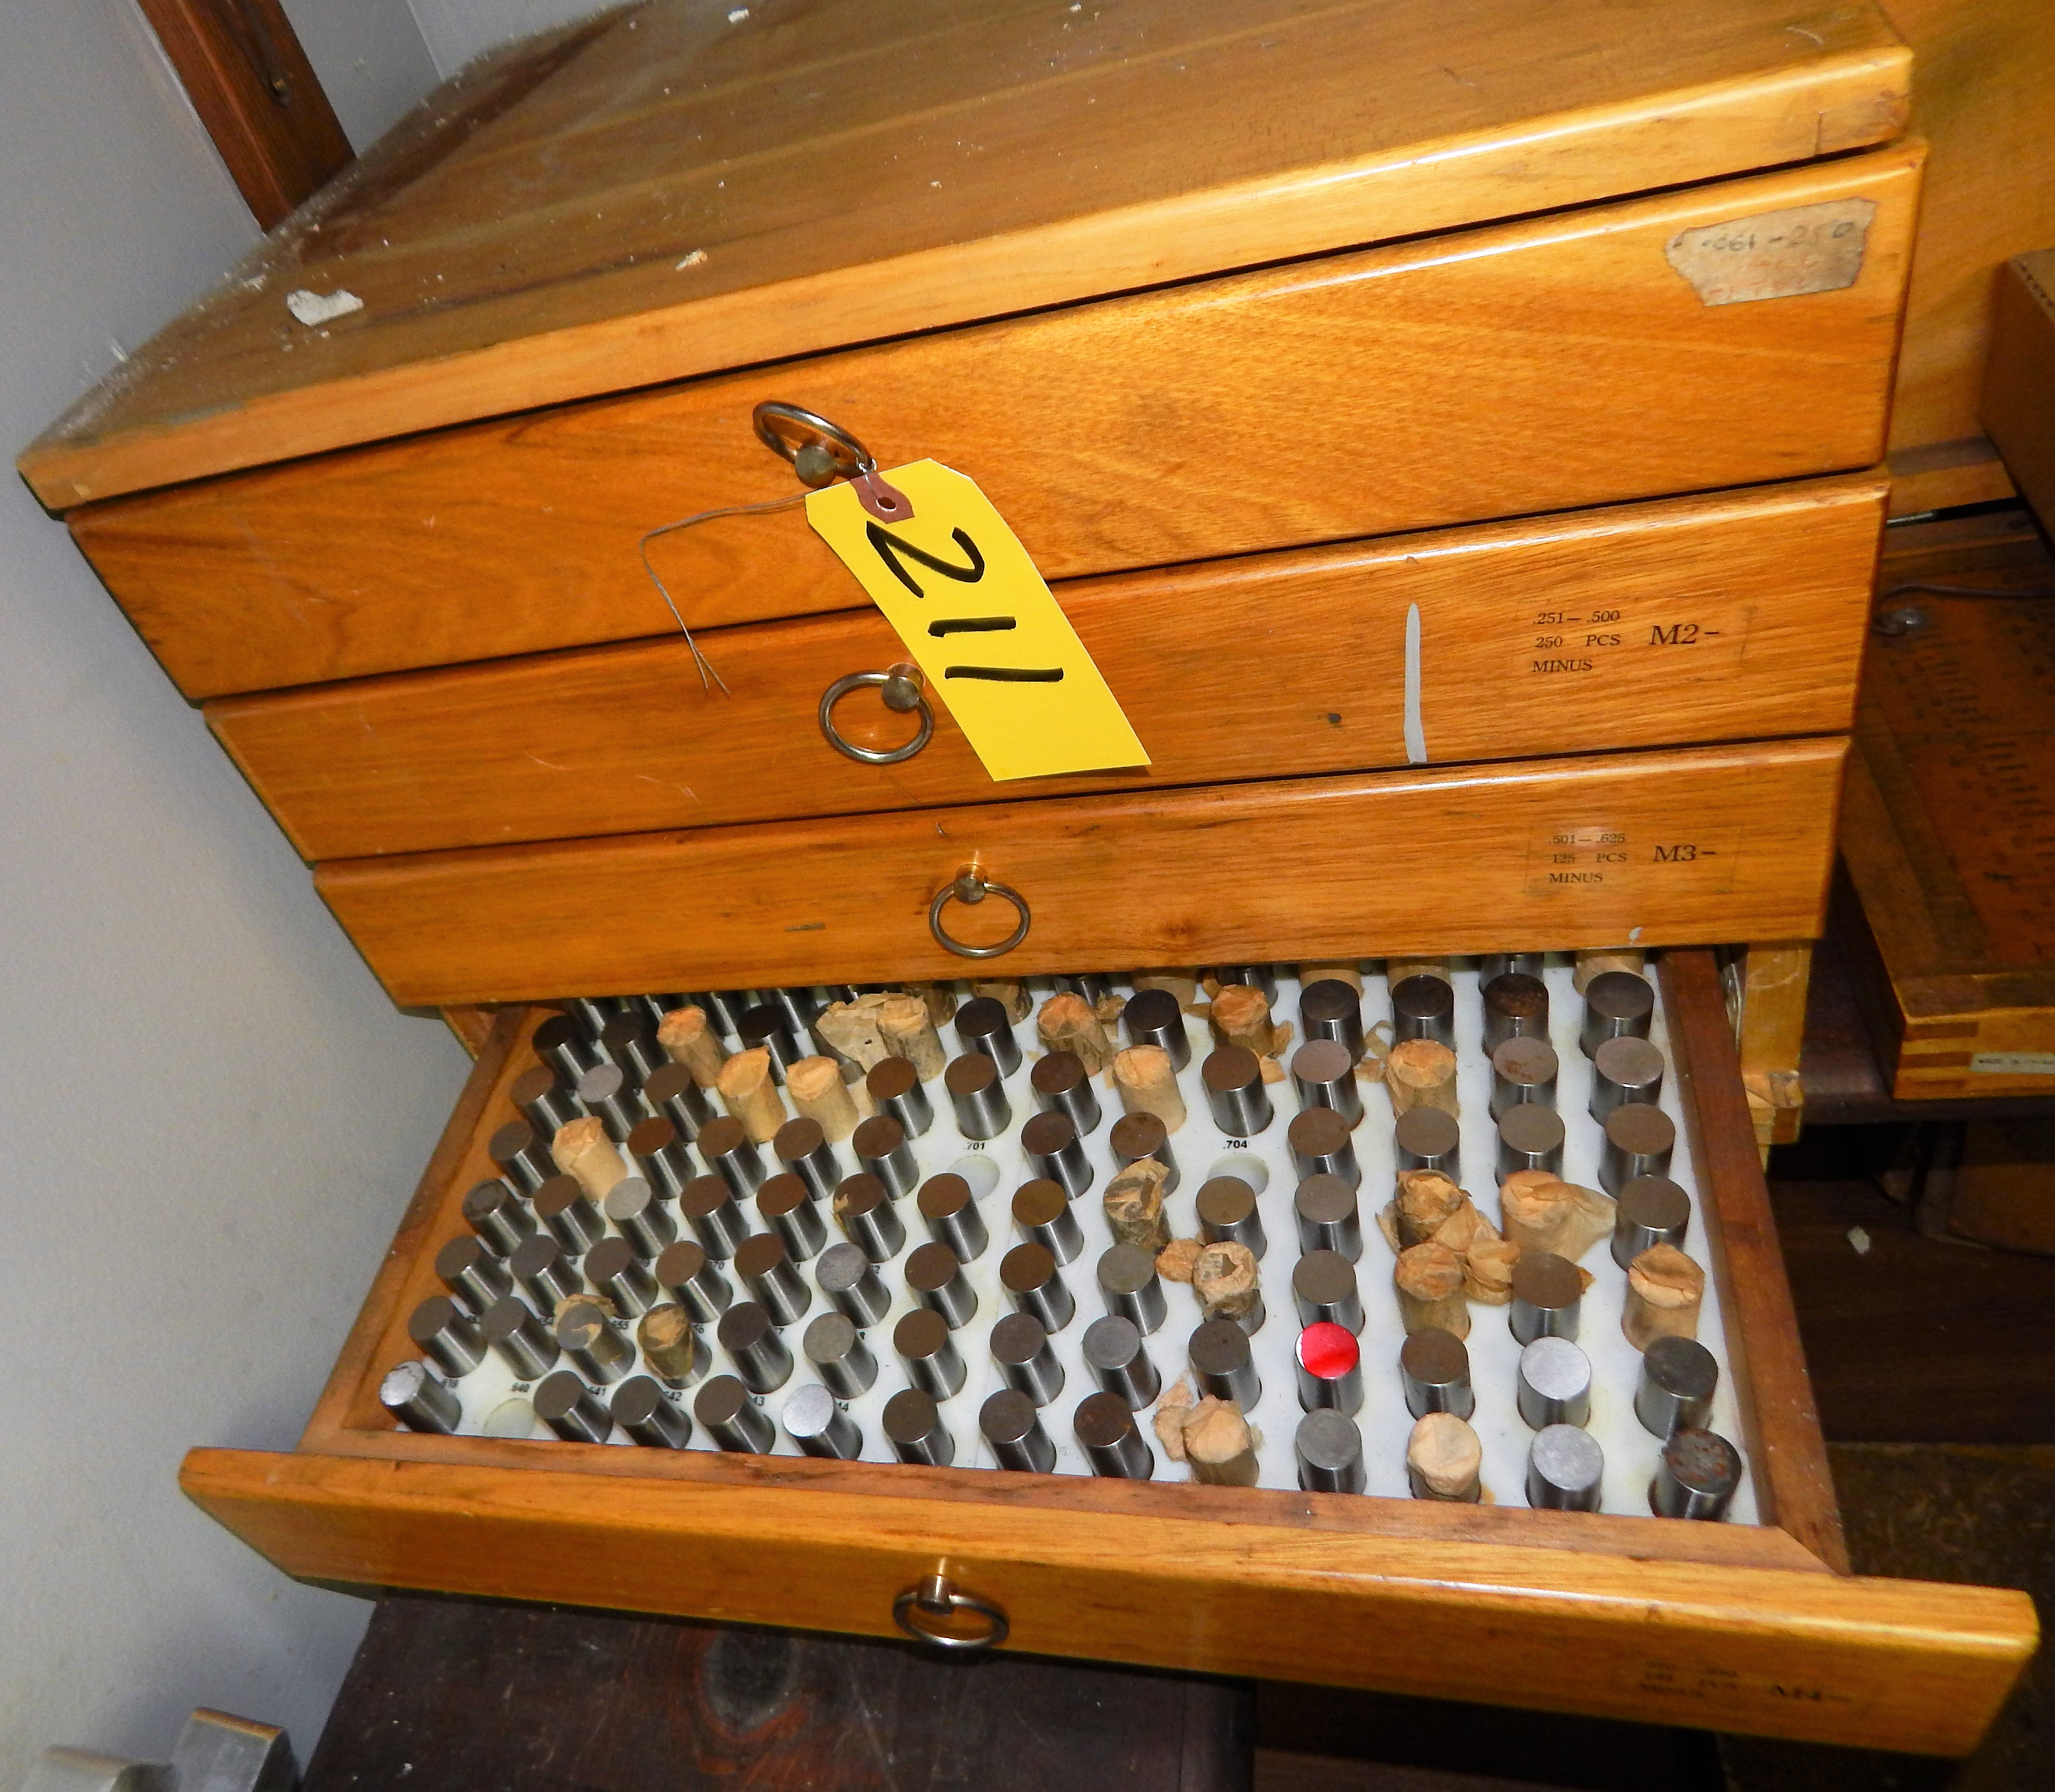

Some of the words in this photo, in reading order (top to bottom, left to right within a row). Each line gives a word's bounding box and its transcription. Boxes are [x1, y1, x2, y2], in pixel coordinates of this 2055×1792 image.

[866, 521, 1064, 682] 211
[1587, 610, 1621, 623] .500
[1535, 636, 1563, 648] 250
[1586, 634, 1621, 647] PCS
[1532, 659, 1593, 673] MINUS
[1596, 852, 1627, 863] PCS
[1549, 872, 1603, 883] MINUS
[1223, 1140, 1247, 1149] .704
